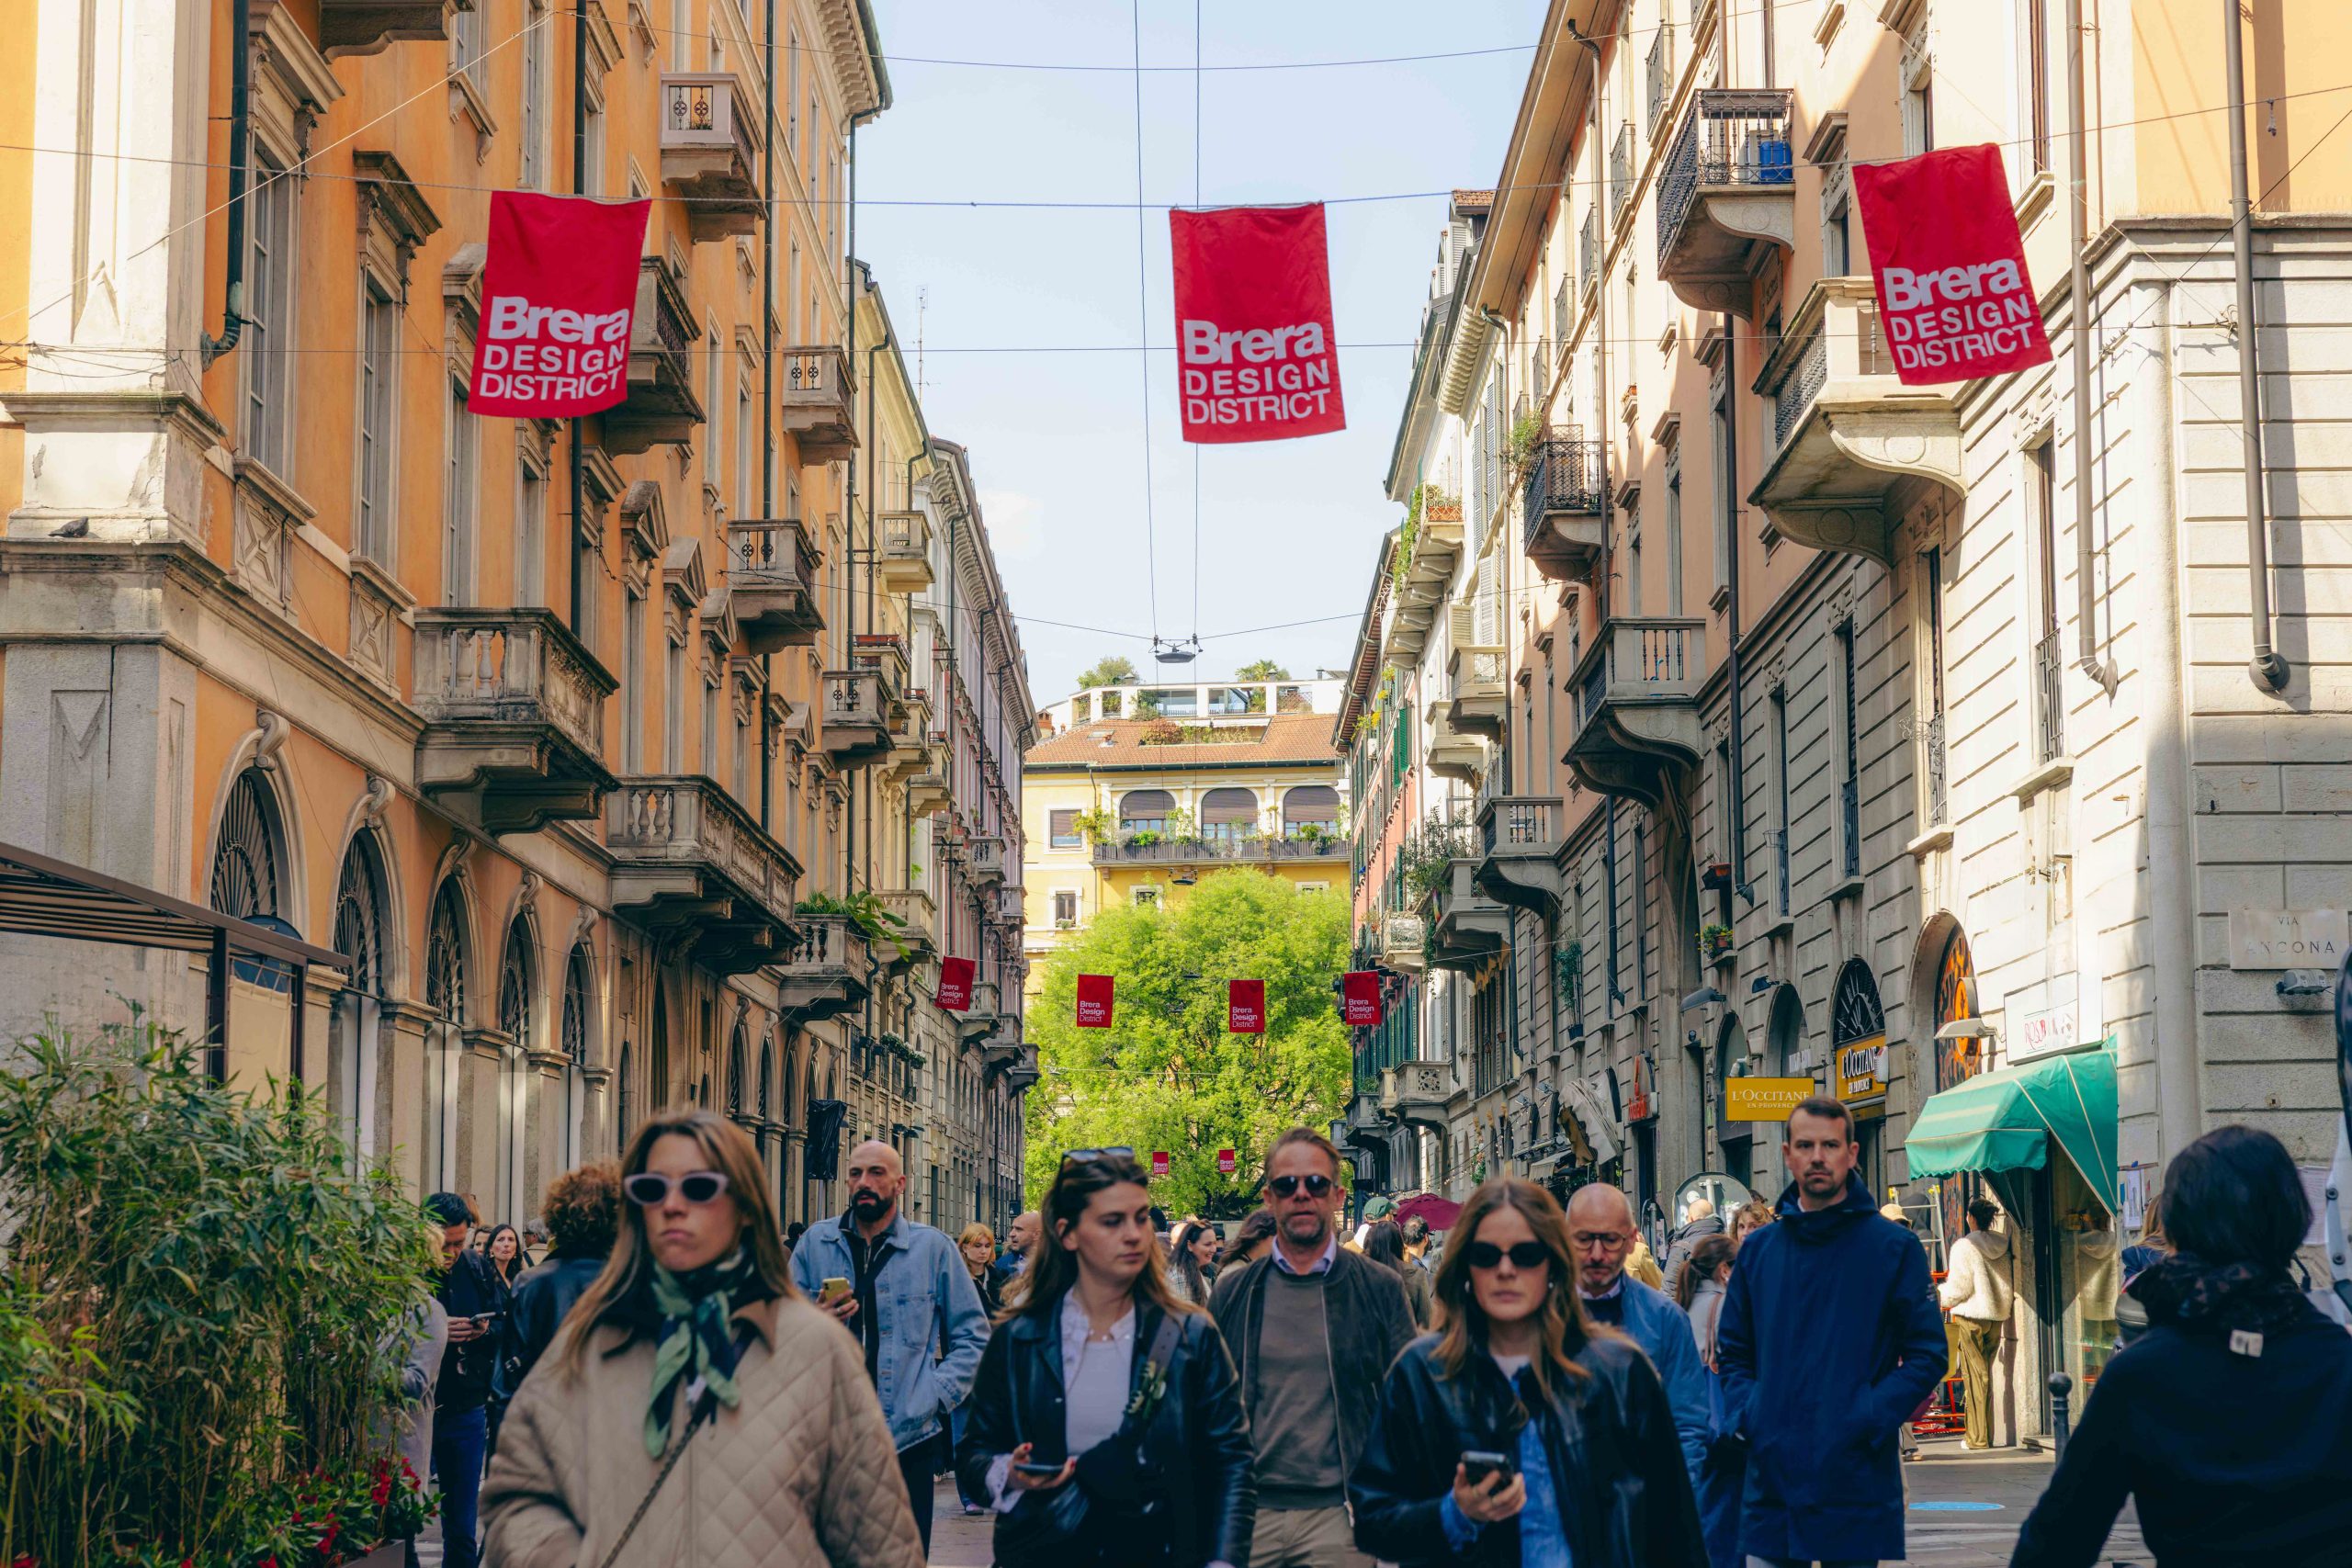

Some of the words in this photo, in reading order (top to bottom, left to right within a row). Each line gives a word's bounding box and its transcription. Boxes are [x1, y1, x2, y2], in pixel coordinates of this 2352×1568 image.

[1883, 258, 2022, 311] Brera
[488, 296, 629, 344] Brera
[1890, 294, 2030, 342] DESIGN
[482, 340, 625, 374] DESIGN
[1182, 319, 1326, 365] Brera
[1896, 321, 2033, 368] DISTRICT
[479, 366, 622, 400] DISTRICT
[1185, 358, 1330, 395] DESIGN
[1187, 389, 1331, 423] DISTRICT
[2278, 917, 2299, 925] VIA
[2246, 941, 2335, 954] ANCONA
[940, 990, 964, 998] Design
[1349, 1005, 1374, 1013] Design
[1080, 1008, 1105, 1016] Design
[1232, 1013, 1258, 1021] Design
